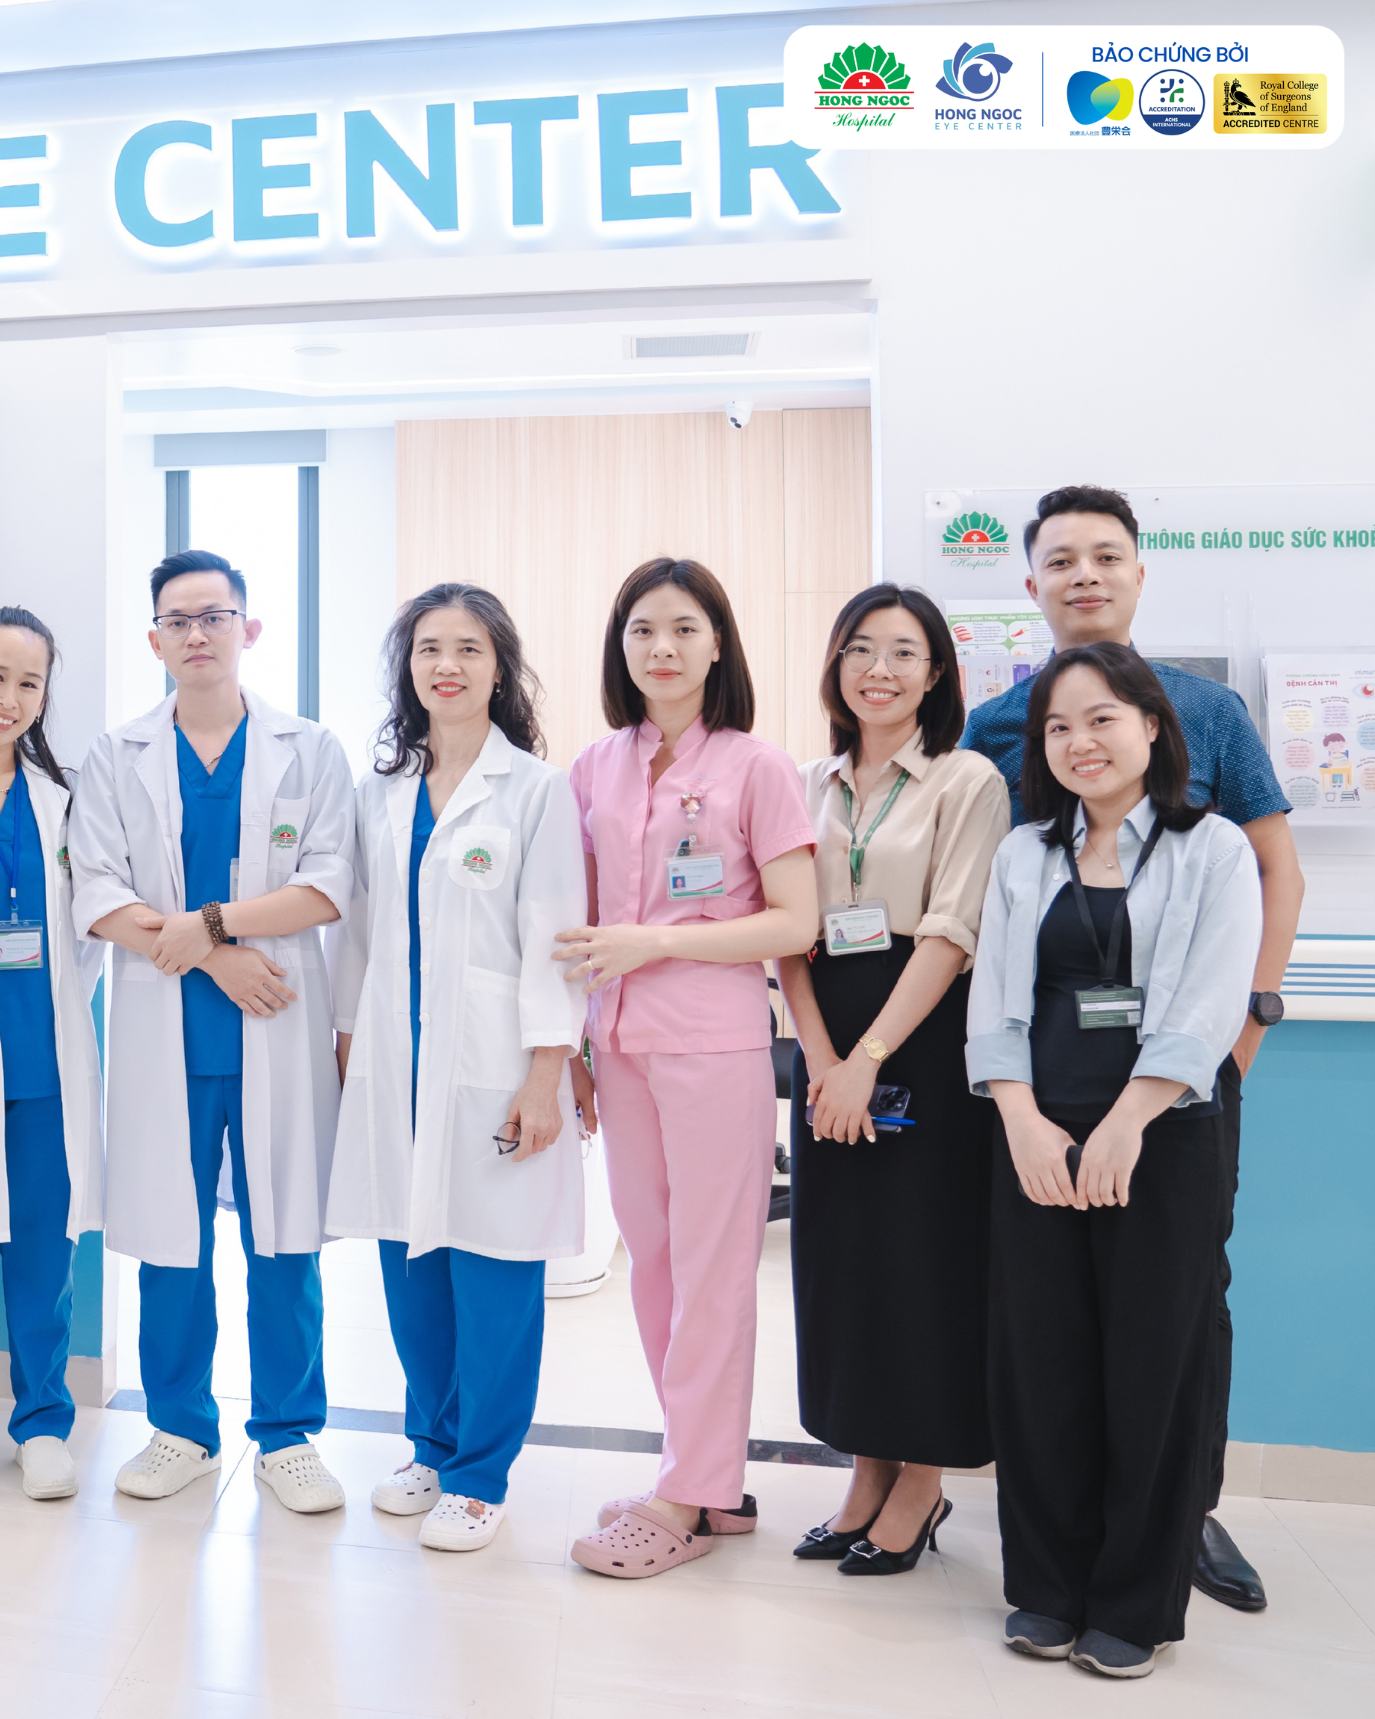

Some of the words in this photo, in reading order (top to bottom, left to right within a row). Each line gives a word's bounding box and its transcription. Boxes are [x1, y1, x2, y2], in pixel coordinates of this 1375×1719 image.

[113, 81, 842, 248] CENTER
[1138, 528, 1195, 550] THÔNG
[1200, 528, 1243, 549] GIÁO
[1249, 530, 1285, 552] DỤC
[1290, 527, 1327, 549] SỨC
[942, 546, 975, 554] HONG
[977, 546, 1010, 554] NGOC
[950, 557, 999, 571] Hospital
[1286, 680, 1307, 688] BỆNH
[1308, 679, 1324, 687] CẬN
